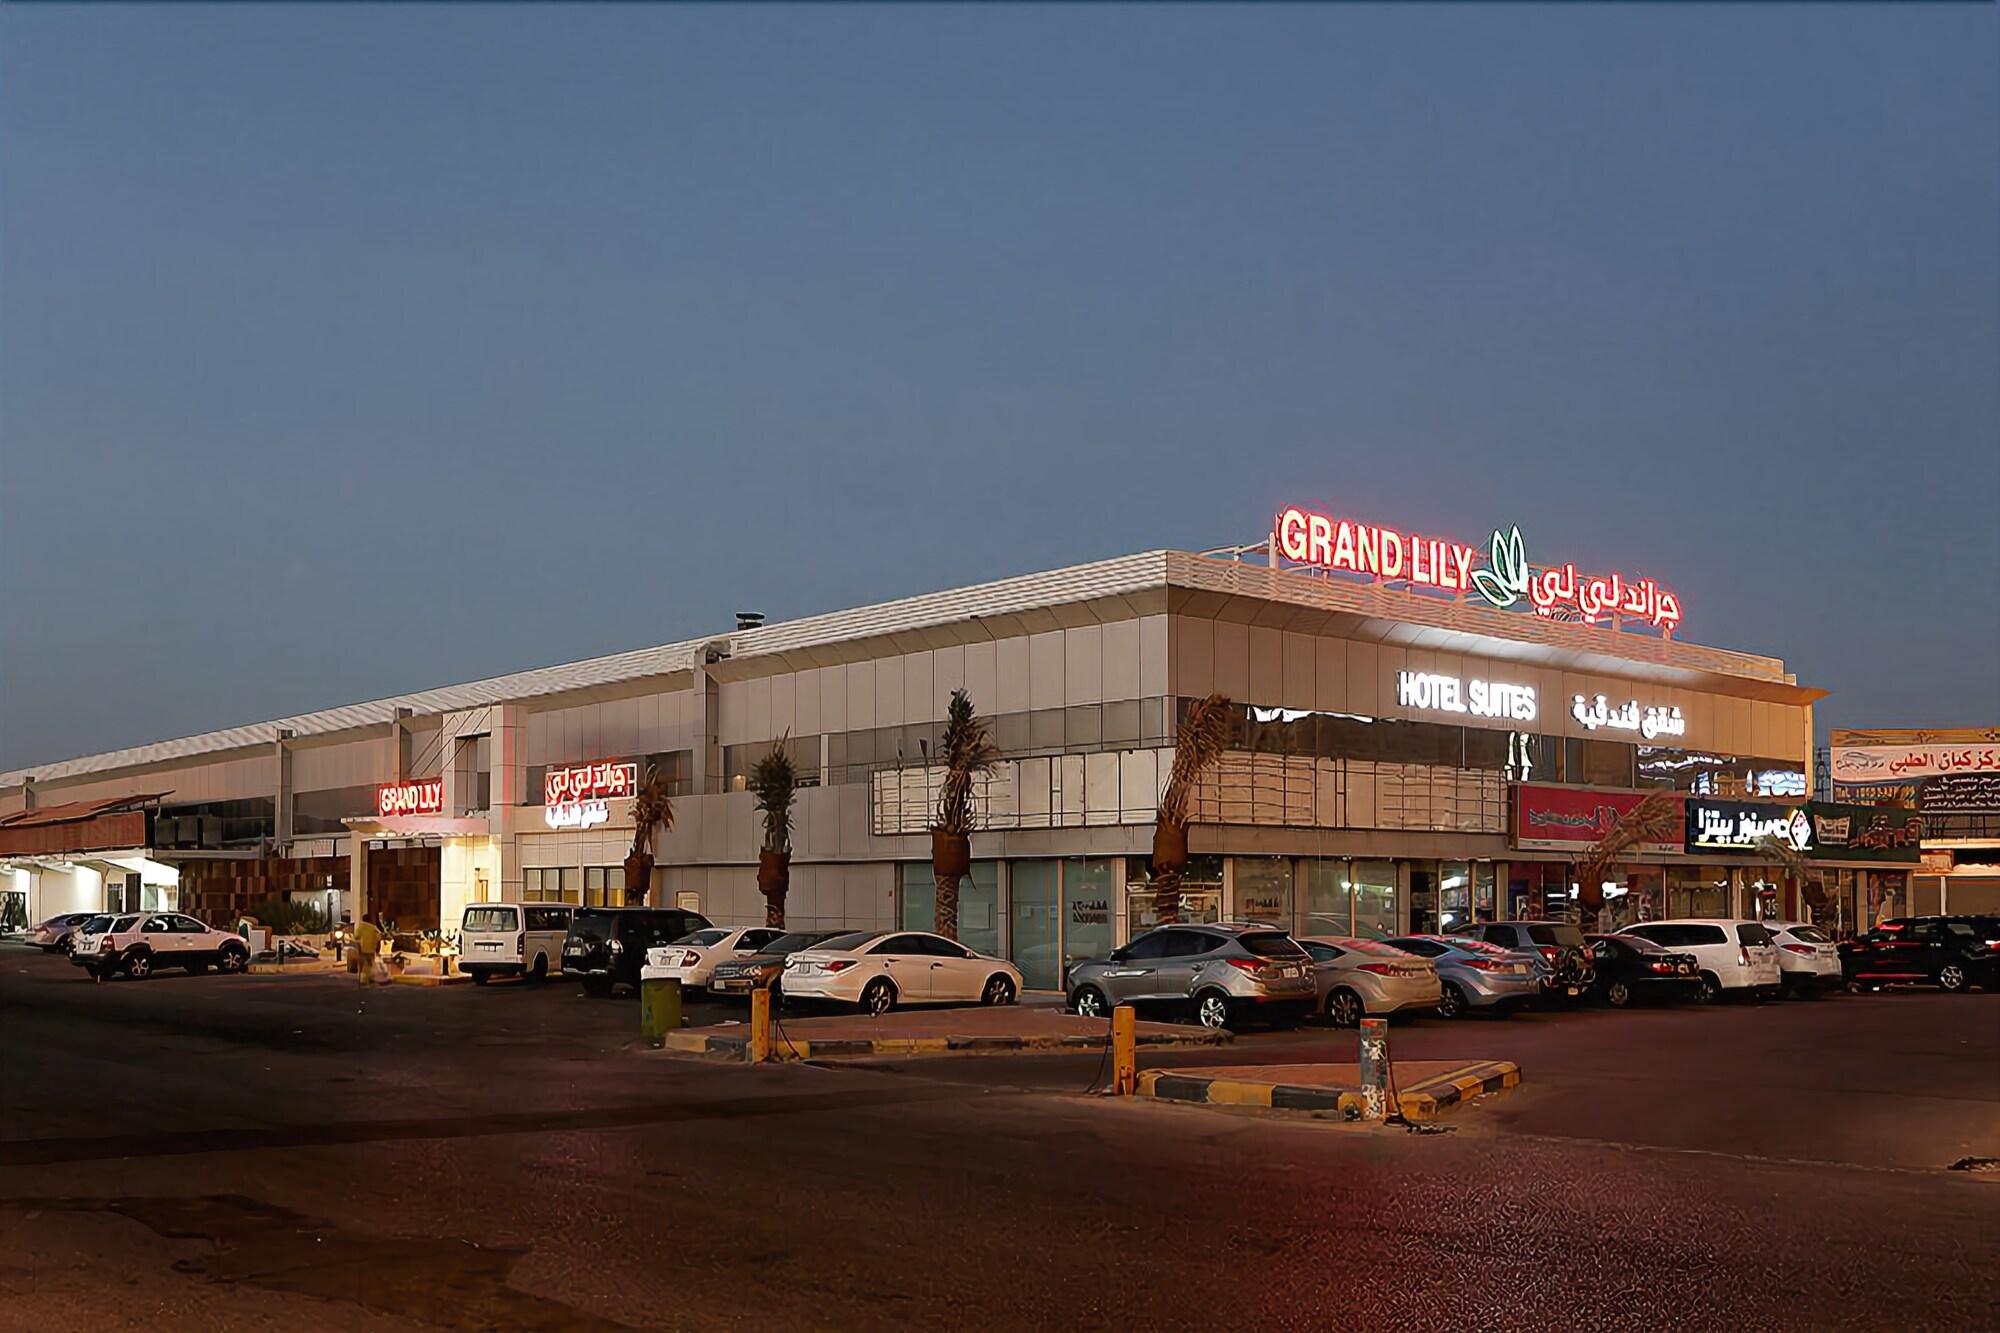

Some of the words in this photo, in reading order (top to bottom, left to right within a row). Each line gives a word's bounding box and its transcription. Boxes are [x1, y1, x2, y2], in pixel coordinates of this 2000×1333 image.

[1280, 509, 1403, 577] GRAND
[1412, 536, 1473, 590] LILY
[1529, 563, 1575, 617] لي
[1579, 573, 1622, 624] لي
[1623, 579, 1681, 630] جراند
[1399, 671, 1467, 713] HOTEL
[1469, 679, 1536, 721] SUITES
[1572, 694, 1640, 731] فندقية
[1641, 706, 1685, 740] شقق
[592, 762, 626, 793] جراند
[1889, 752, 1936, 776] الطبي
[1973, 750, 2000, 771] ركز
[1698, 807, 1734, 844] بيتزا
